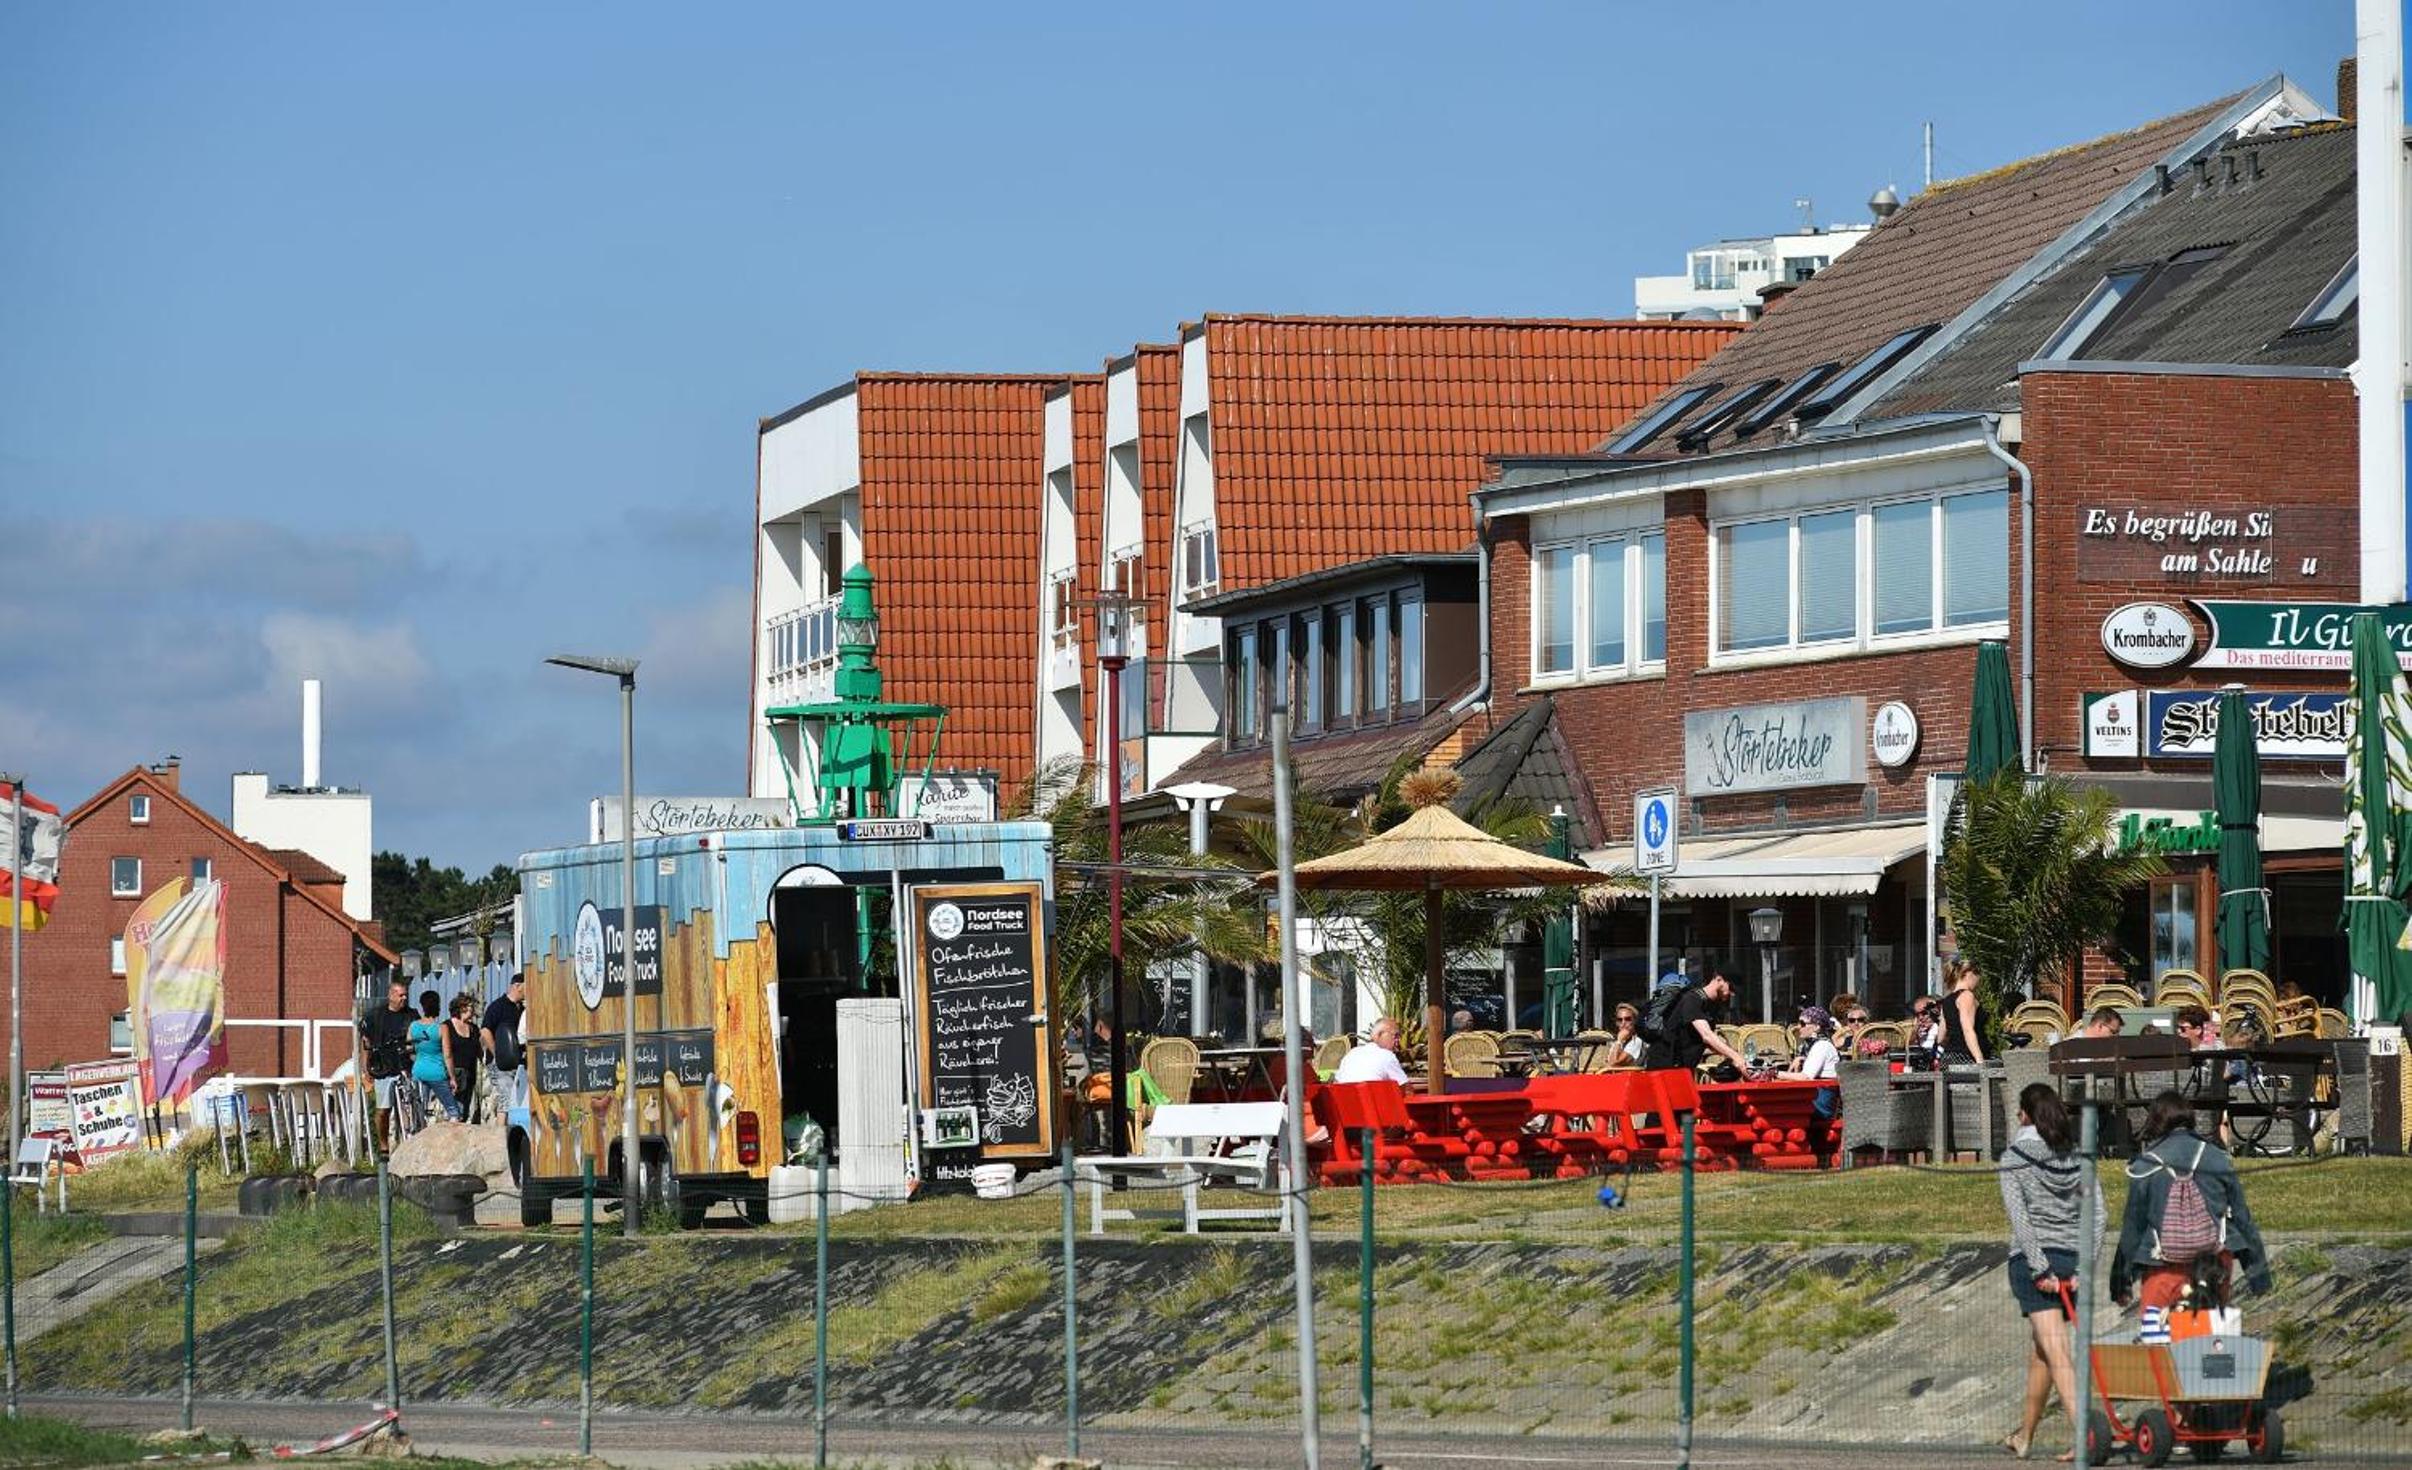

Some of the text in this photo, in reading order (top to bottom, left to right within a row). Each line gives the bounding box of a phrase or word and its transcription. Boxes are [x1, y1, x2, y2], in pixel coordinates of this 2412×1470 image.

[2083, 508, 2117, 535] Es
[2124, 510, 2238, 542] begrüßen
[2160, 553, 2198, 573] am
[2204, 548, 2272, 574] Sahle
[2267, 608, 2310, 646] Il
[2113, 628, 2188, 649] Krombacher
[2227, 650, 2254, 666] Das
[2095, 726, 2132, 737] VELTINS
[1722, 713, 1832, 787] Störtebeker
[649, 799, 763, 836] Störtebeker
[1646, 851, 1665, 865] ZONE
[967, 920, 1024, 931] Food Truck
[932, 942, 1013, 964] Ofenfrische
[933, 963, 1028, 985] Fischbrötchen
[932, 995, 1027, 1019] Täglich frischer
[936, 1014, 1014, 1035] Räucherfisch
[938, 1039, 959, 1050] aus
[2377, 1038, 2392, 1053] 16
[72, 1084, 123, 1106] Taschen
[94, 1105, 103, 1117] &
[78, 1116, 124, 1137] Schuhe
